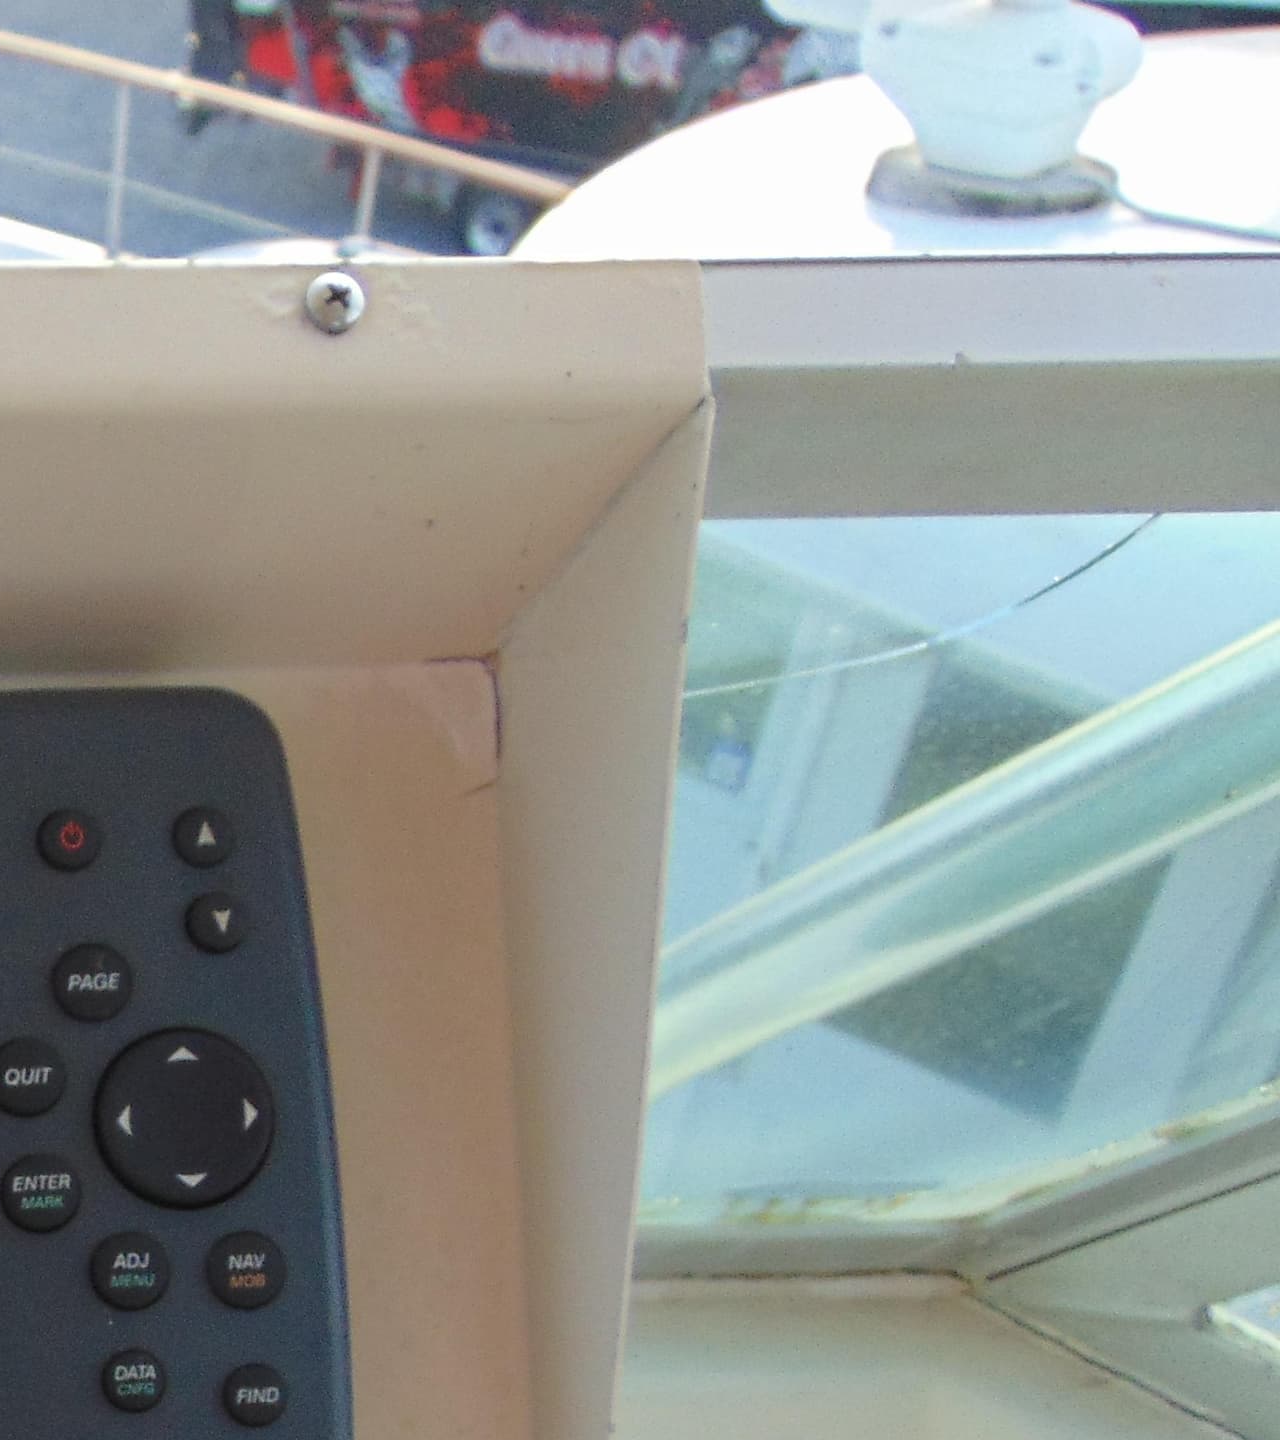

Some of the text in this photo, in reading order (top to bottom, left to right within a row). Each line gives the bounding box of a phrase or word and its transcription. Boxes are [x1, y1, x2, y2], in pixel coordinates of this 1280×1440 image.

[67, 973, 120, 992] PAGE
[4, 1066, 52, 1086] QUIT
[12, 1173, 71, 1193] ENTER
[20, 1195, 64, 1209] MARK
[113, 1253, 149, 1269] ADJ
[228, 1253, 265, 1270] NAV
[110, 1274, 156, 1289] MENU
[229, 1274, 266, 1289] MOB
[114, 1365, 156, 1381] DATA
[236, 1387, 279, 1405] FIND
